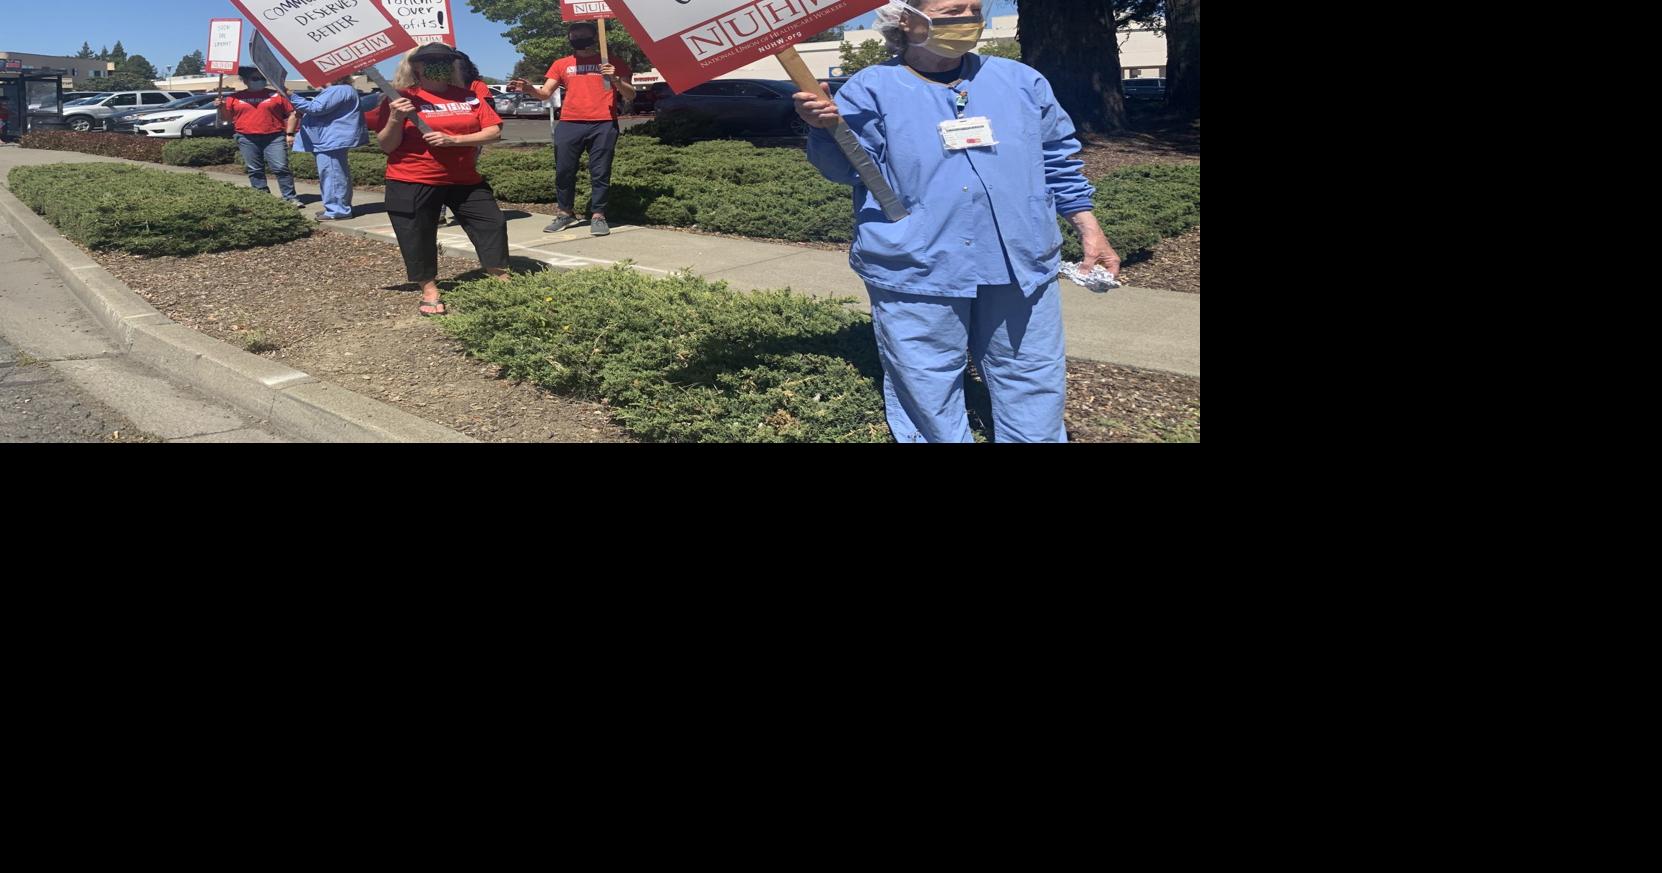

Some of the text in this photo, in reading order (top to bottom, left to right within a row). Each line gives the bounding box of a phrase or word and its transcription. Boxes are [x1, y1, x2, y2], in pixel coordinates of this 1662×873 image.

[397, 6, 434, 17] Over
[402, 10, 445, 30] ofits!
[306, 14, 360, 43] BETTER
[317, 34, 389, 70] NUHW
[757, 31, 802, 53] NUHW.org
